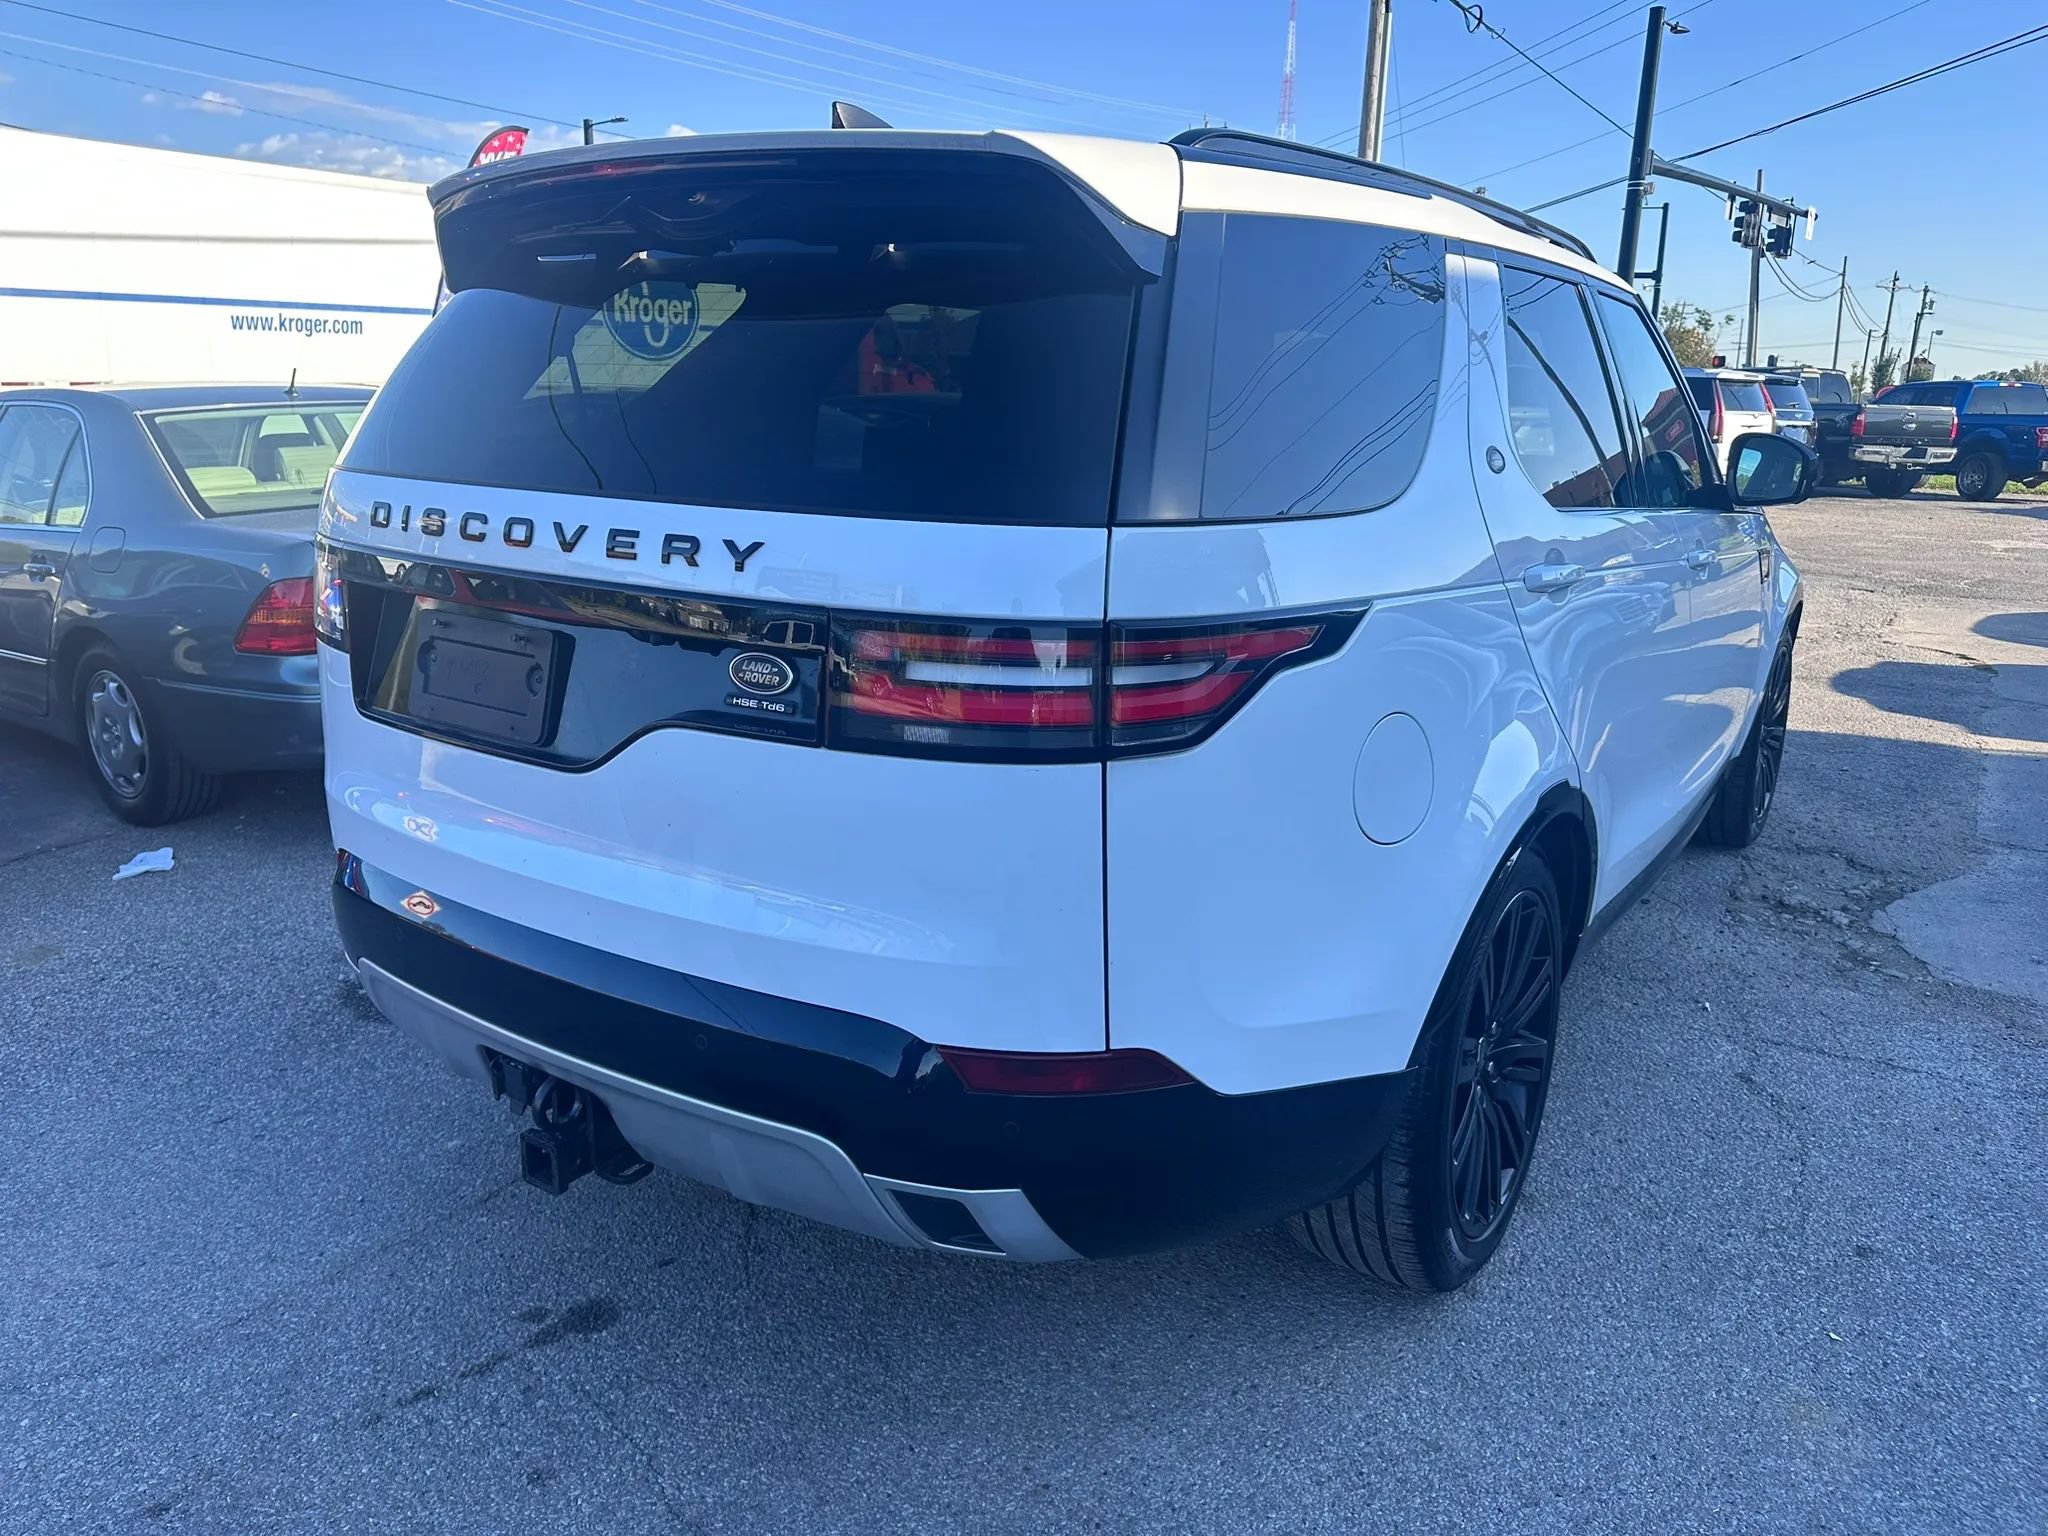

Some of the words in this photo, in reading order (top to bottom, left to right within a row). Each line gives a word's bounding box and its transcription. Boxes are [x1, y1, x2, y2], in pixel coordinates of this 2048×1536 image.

[230, 312, 363, 337] www.kroger.com
[613, 282, 692, 347] Kroger
[370, 500, 765, 572] DISCOVERY
[742, 660, 771, 674] LAND
[743, 671, 780, 686] ROVER
[732, 697, 758, 708] HSE
[761, 701, 785, 712] Td6
